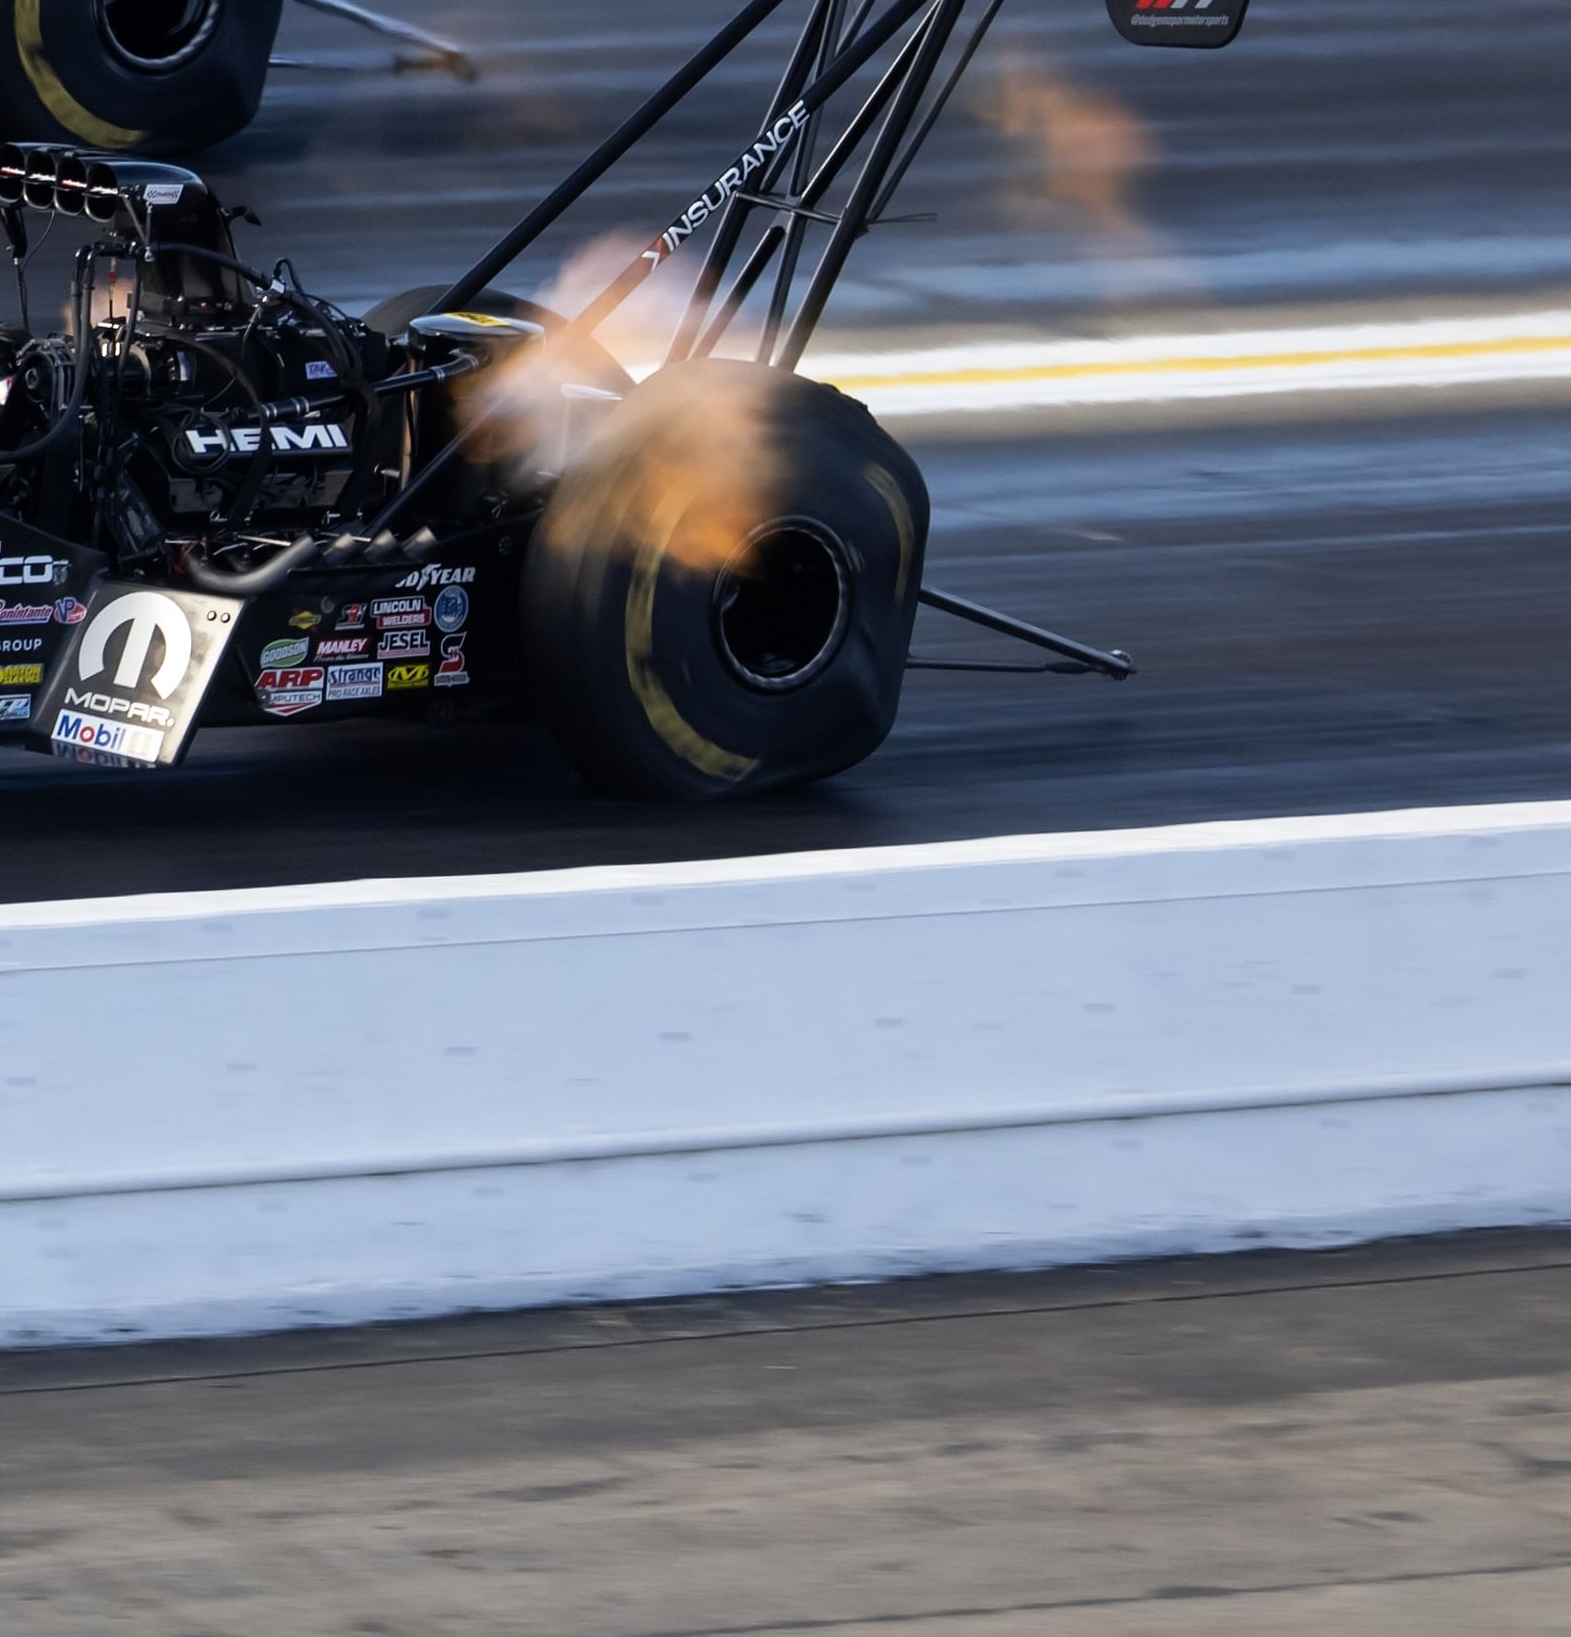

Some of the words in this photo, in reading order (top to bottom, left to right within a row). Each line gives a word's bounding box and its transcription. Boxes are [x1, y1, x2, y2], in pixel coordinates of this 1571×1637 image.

[662, 100, 810, 252] INSURANCE
[186, 424, 348, 453] HEMI
[373, 599, 421, 615] LINCOLN
[383, 614, 425, 626] WELDERS
[317, 638, 368, 654] MANLEY
[380, 632, 429, 651] JESEL
[259, 669, 323, 689] ARP
[57, 714, 126, 751] Mobil
